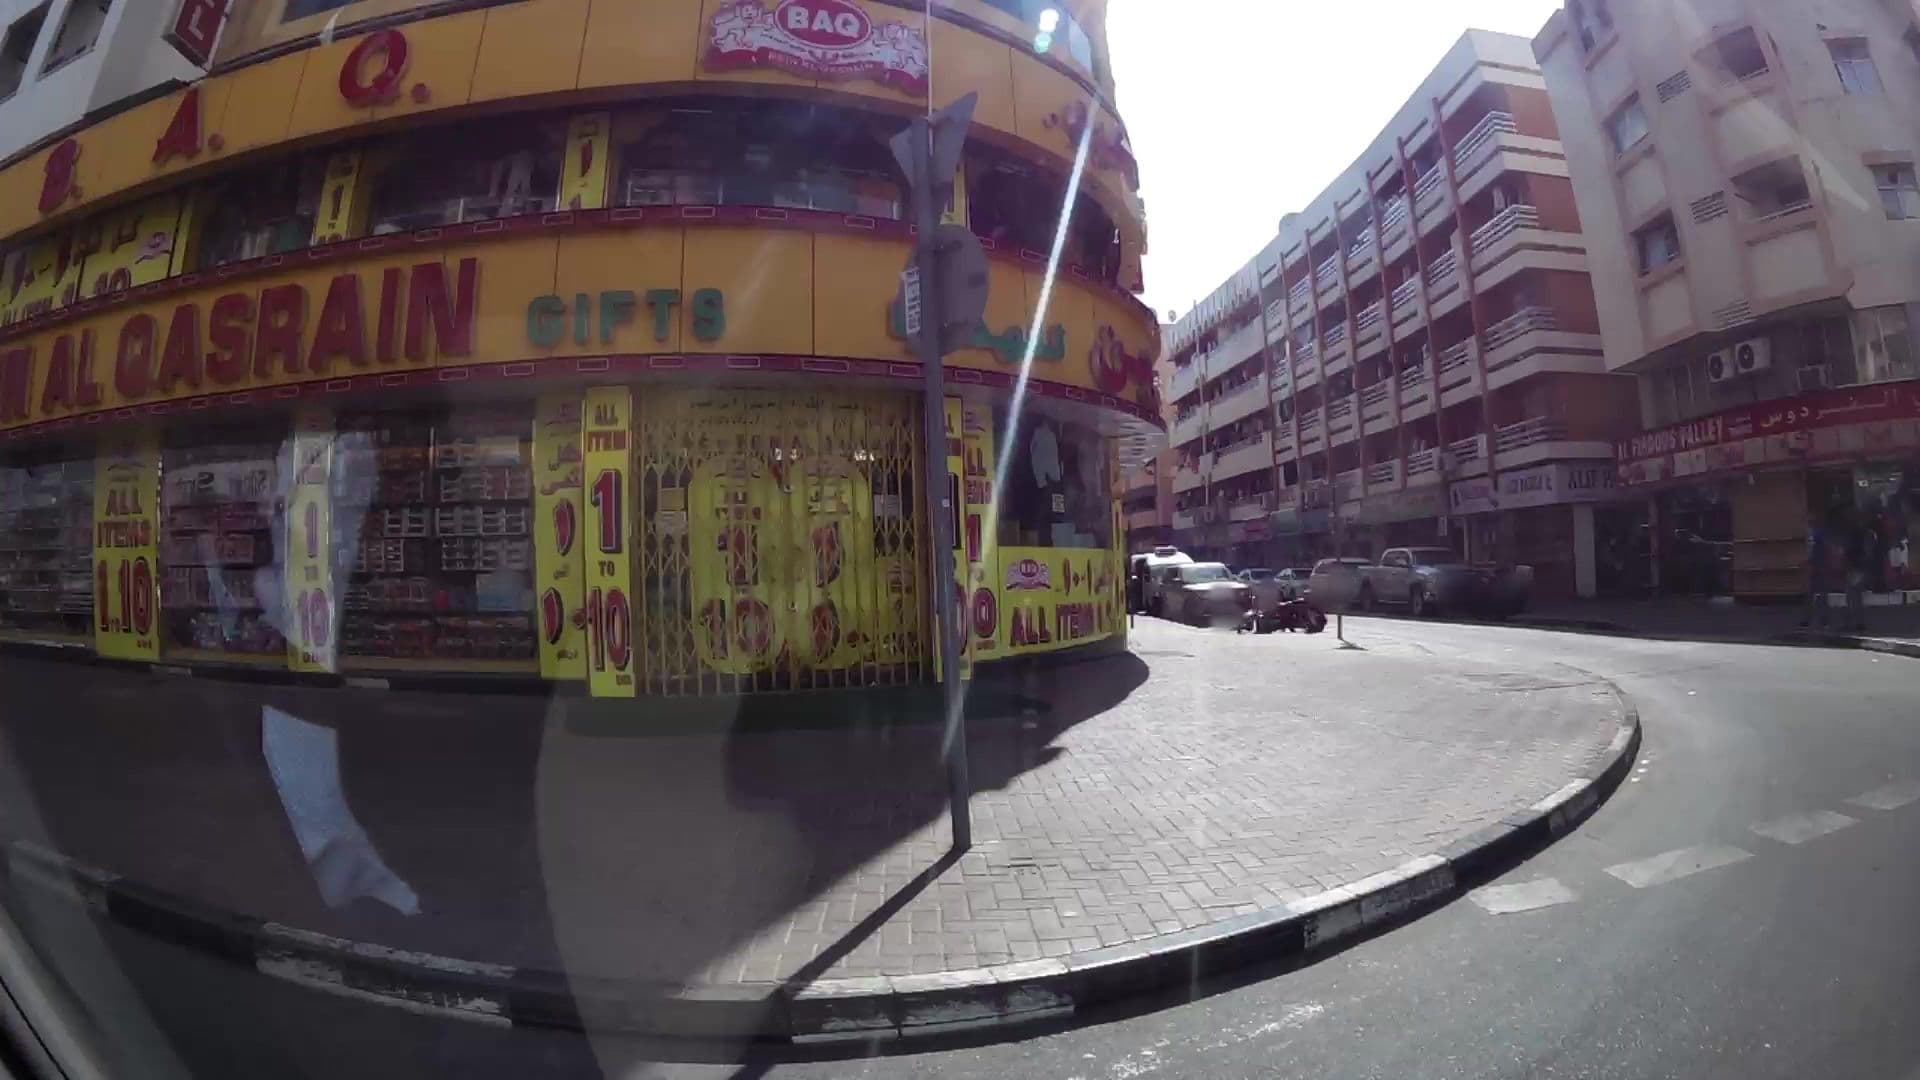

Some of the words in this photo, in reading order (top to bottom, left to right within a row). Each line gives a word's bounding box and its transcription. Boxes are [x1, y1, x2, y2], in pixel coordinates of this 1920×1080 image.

[786, 6, 861, 38] BAQ
[338, 28, 432, 107] Q.
[40, 327, 99, 415] AL
[114, 257, 480, 400] QASRAIN
[526, 287, 727, 347] GIFTS
[594, 403, 618, 425] ALL
[1680, 415, 1723, 448] VALLEY
[105, 488, 142, 515] ALL
[591, 468, 623, 553] 1
[598, 560, 616, 577] TO
[587, 586, 631, 672] 10
[1009, 605, 1050, 647] ALL
